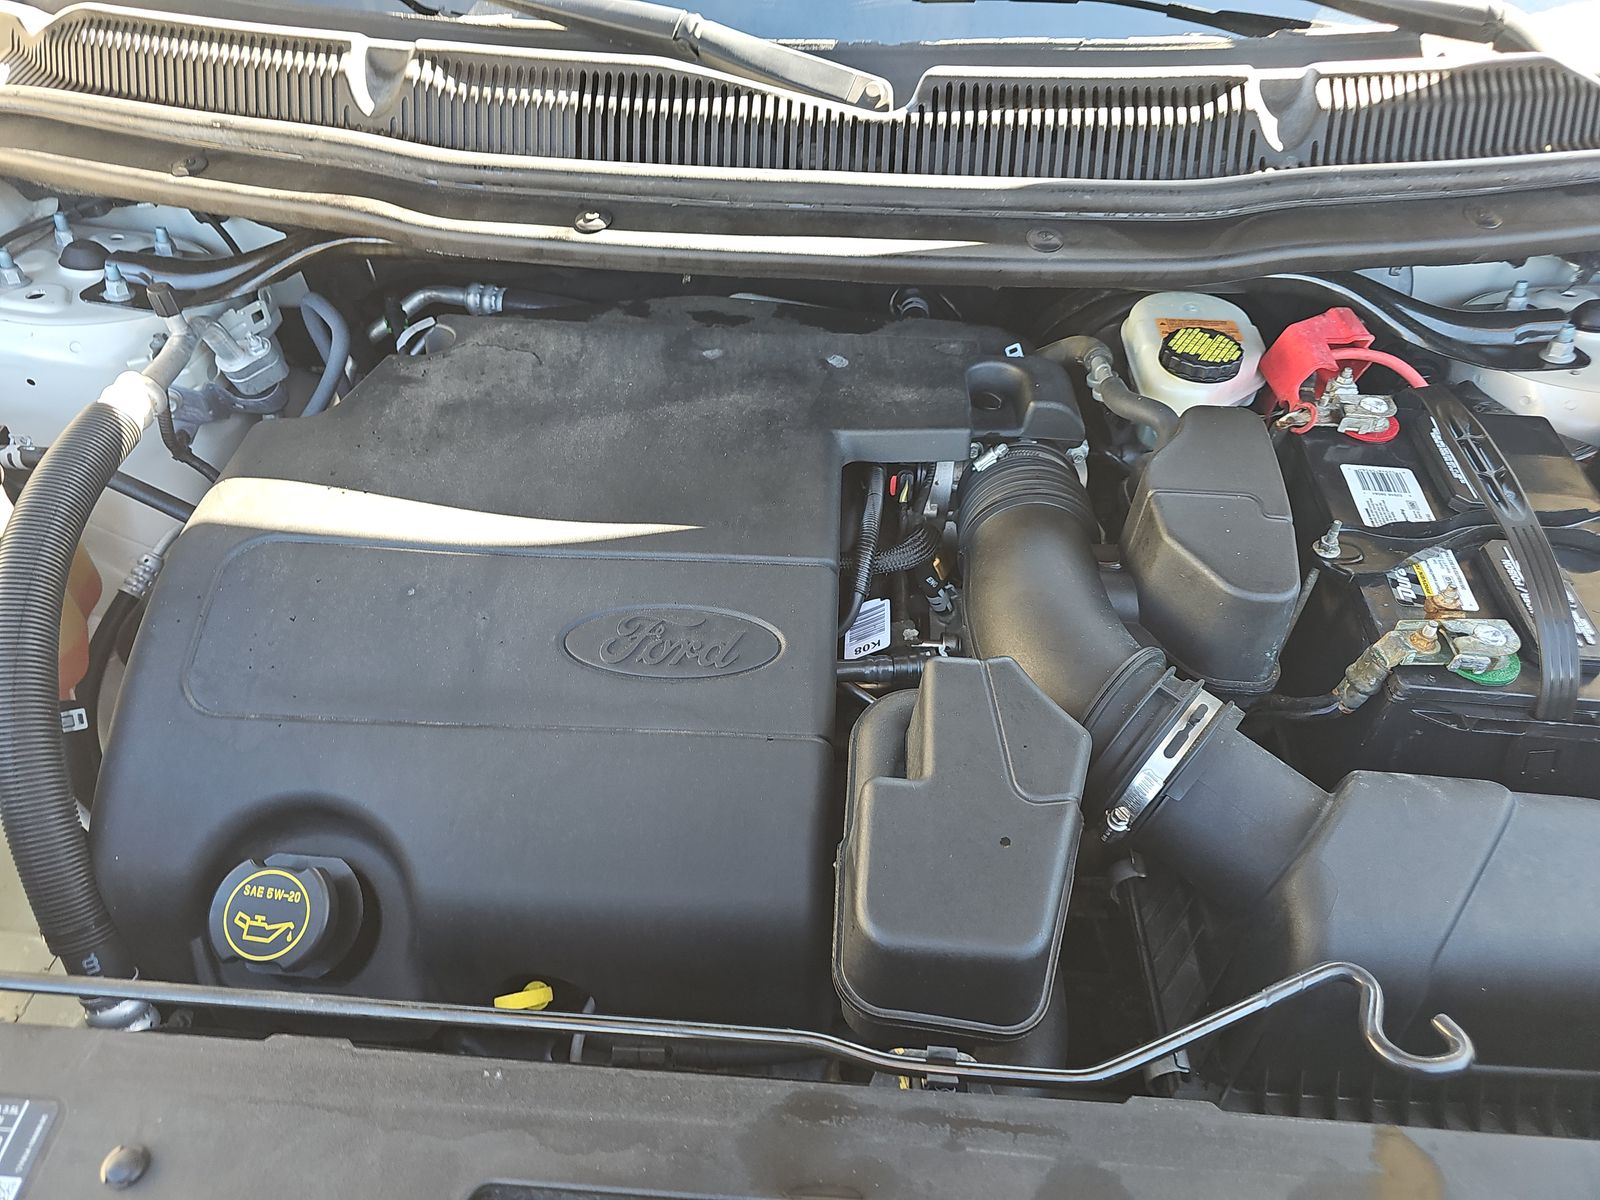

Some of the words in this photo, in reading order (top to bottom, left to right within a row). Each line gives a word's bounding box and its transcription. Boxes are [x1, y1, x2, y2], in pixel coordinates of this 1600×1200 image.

[1500, 558, 1525, 587] POISON
[600, 615, 746, 669] Ford
[854, 639, 881, 655] K08
[243, 883, 265, 898] SAE
[266, 887, 302, 903] 5W-20
